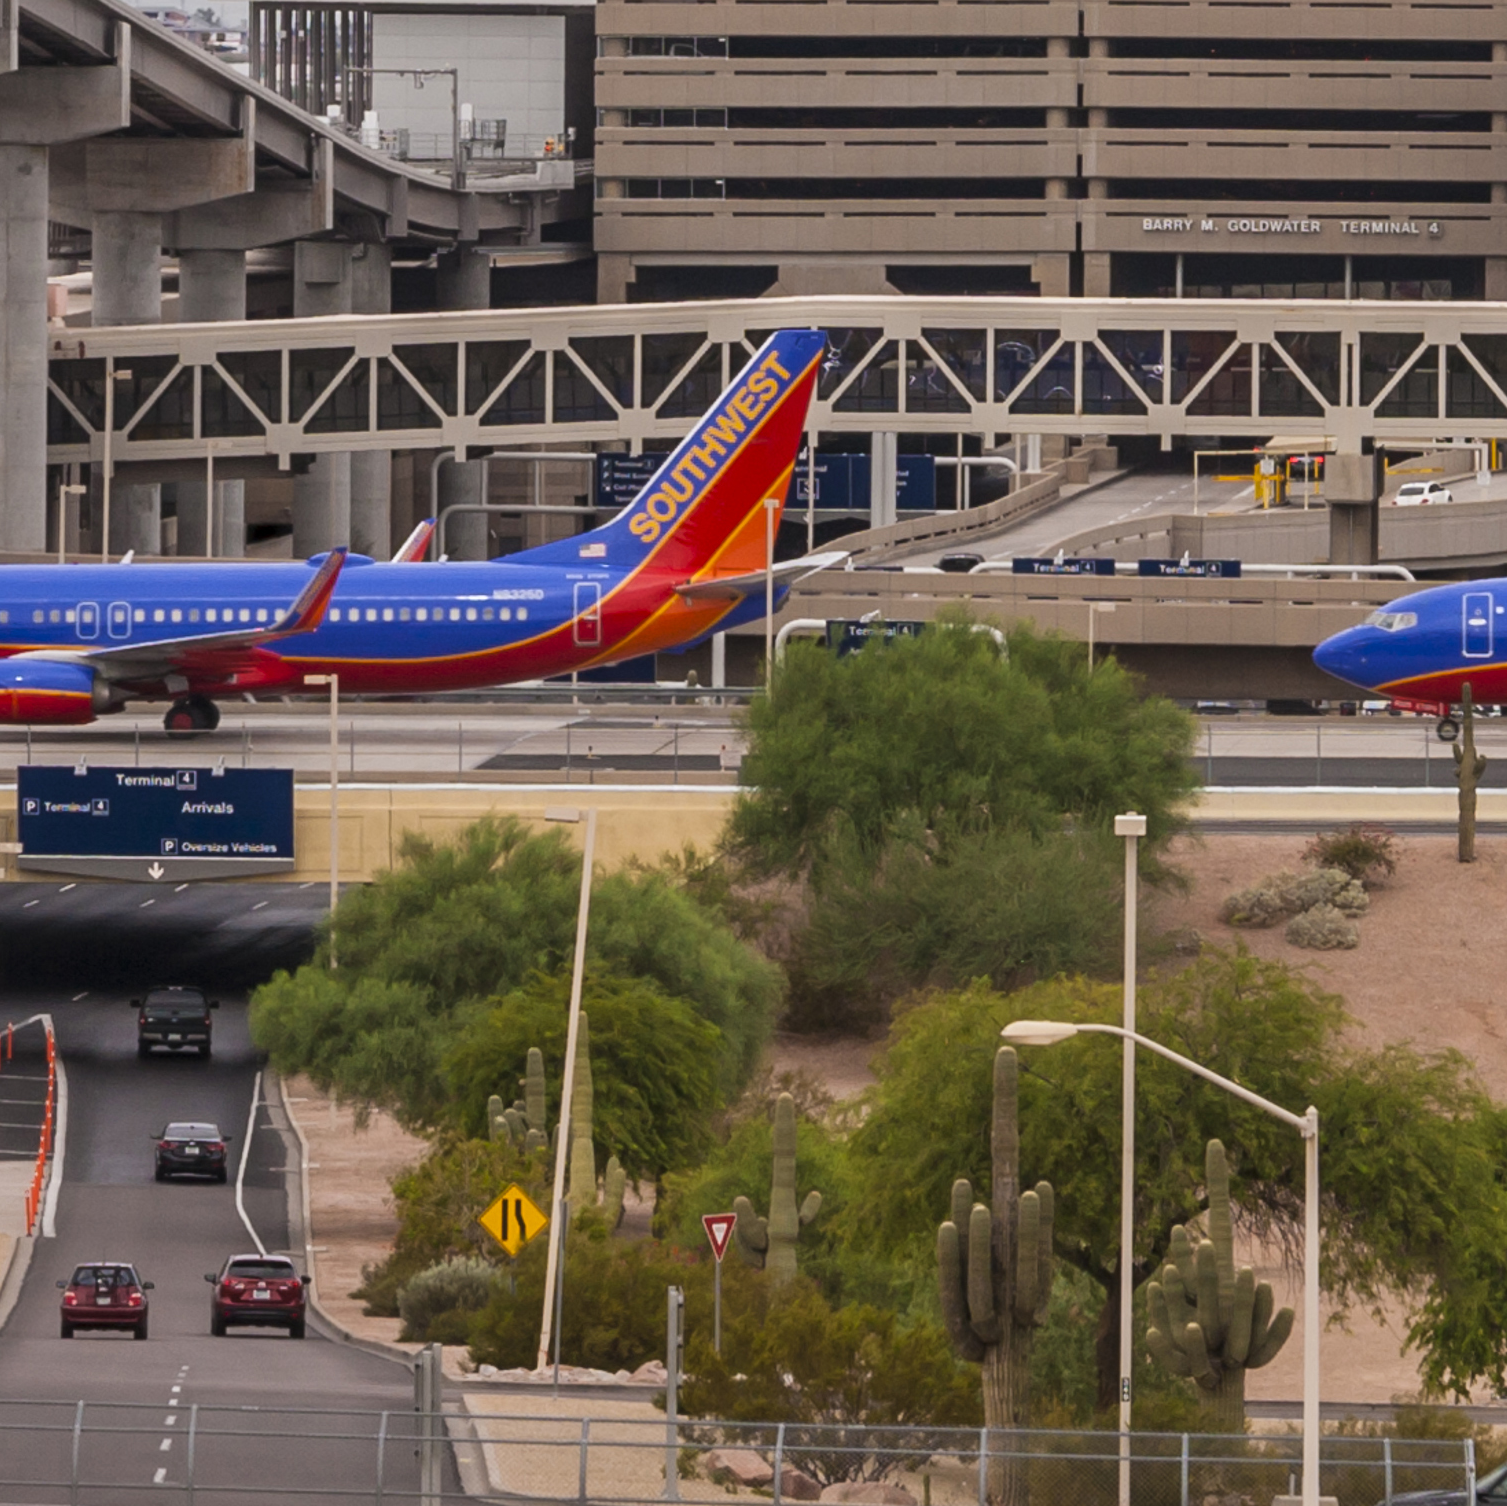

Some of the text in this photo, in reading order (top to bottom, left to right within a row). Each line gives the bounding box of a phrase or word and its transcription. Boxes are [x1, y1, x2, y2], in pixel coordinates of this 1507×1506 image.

[1142, 218, 1441, 235] BARRY M. GOLDWATER TERMINAL 4
[628, 349, 792, 544] SOUTHWEST
[1032, 562, 1080, 573] Terminal
[1159, 563, 1205, 574] Terminal
[116, 772, 191, 787] Terminal 4
[44, 801, 91, 812] Terminal
[181, 801, 234, 814] Arrivals
[181, 842, 229, 853] Oversize
[231, 842, 277, 854] Vehicles
